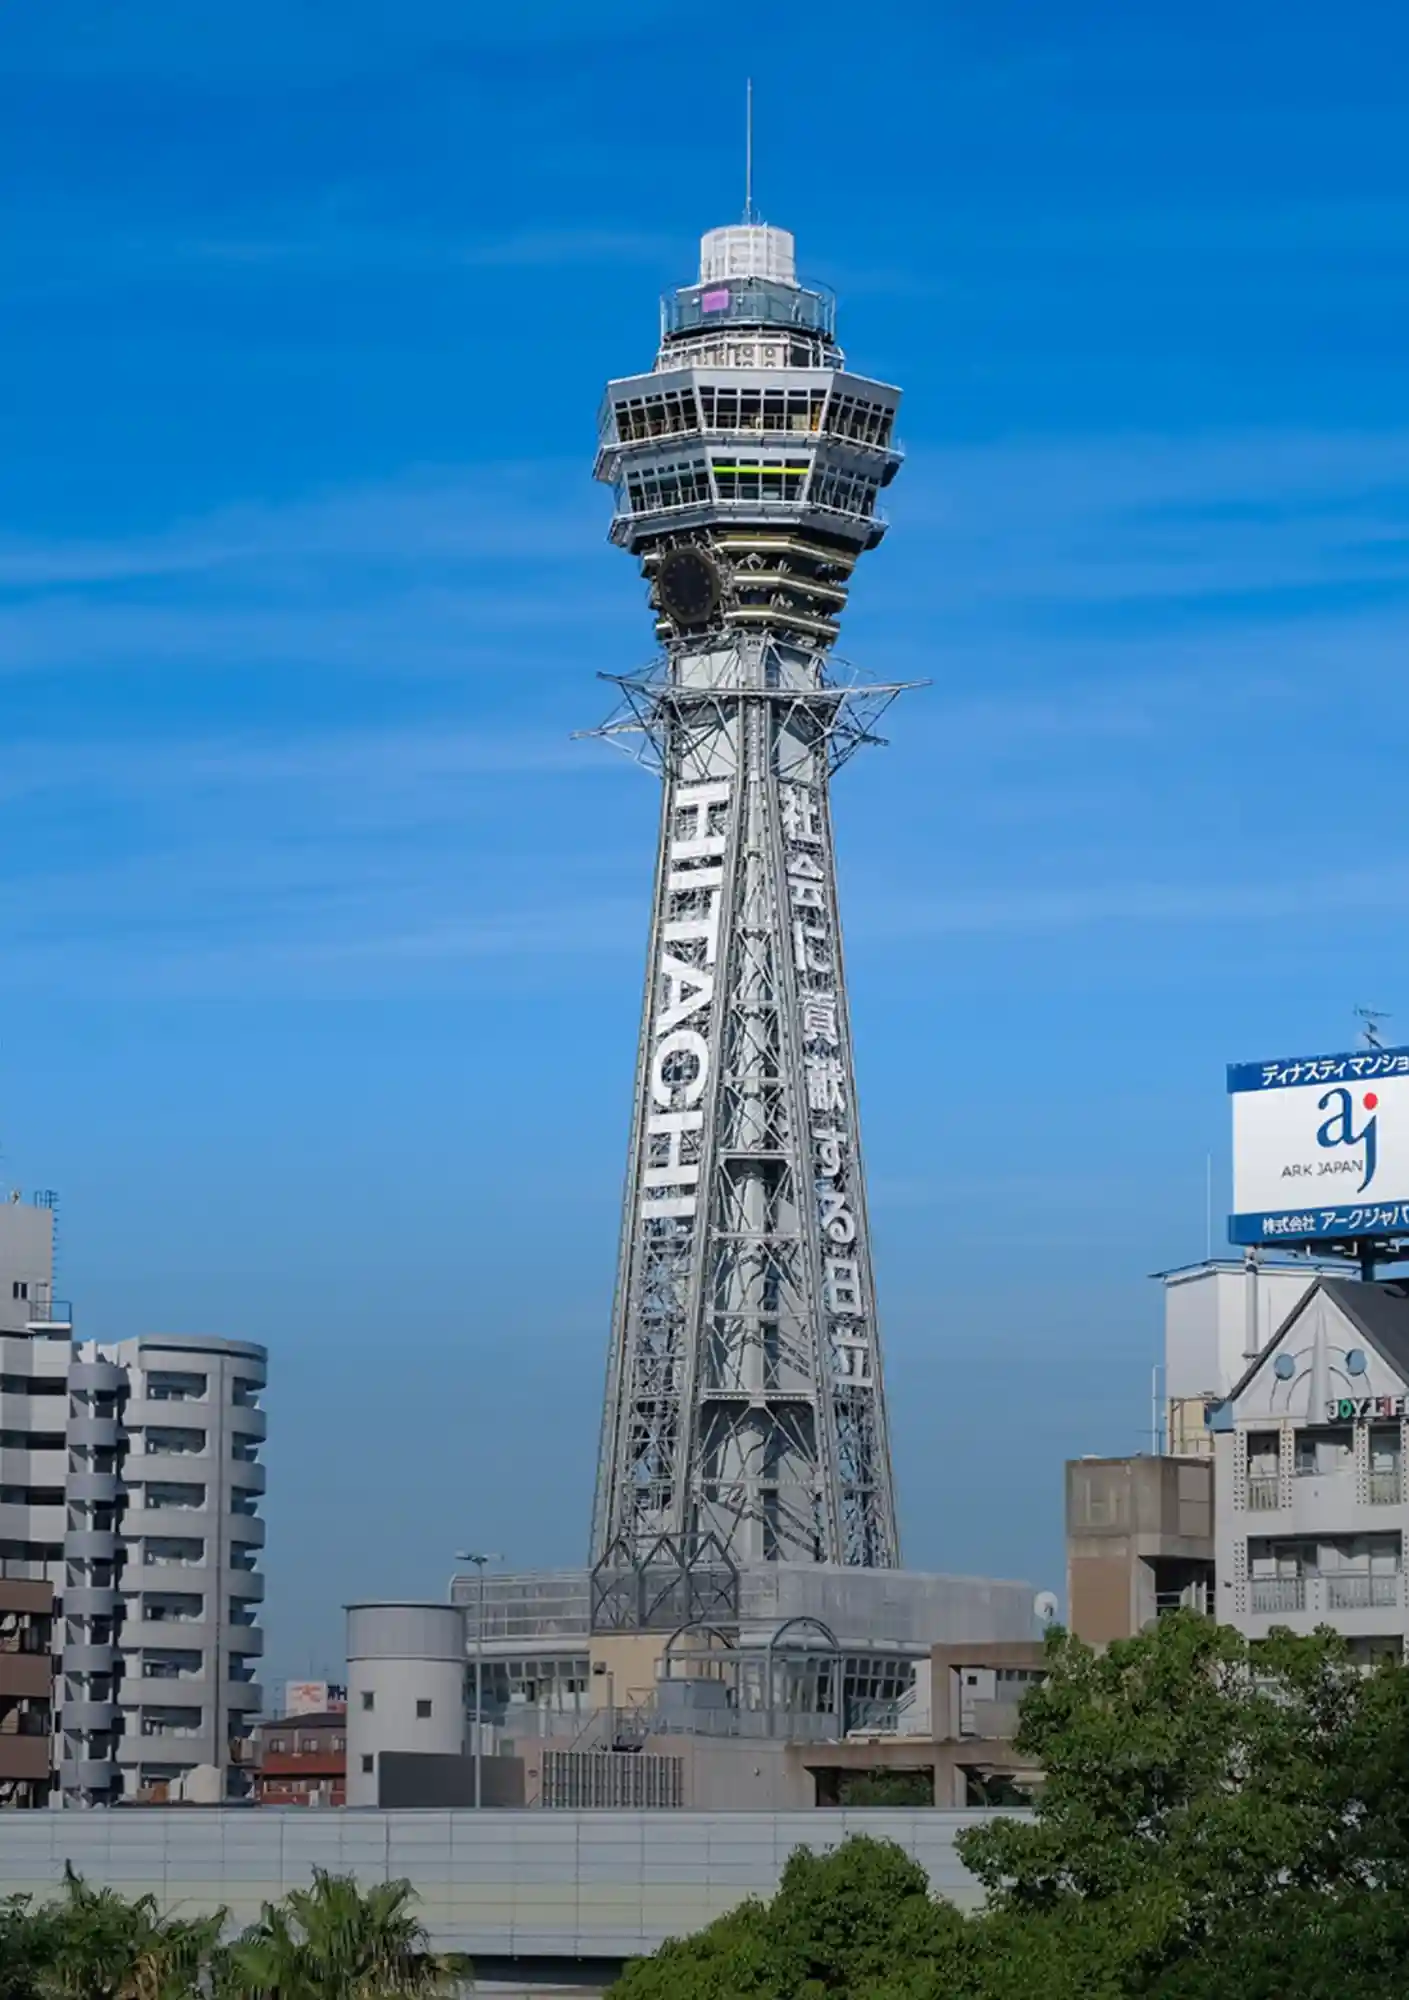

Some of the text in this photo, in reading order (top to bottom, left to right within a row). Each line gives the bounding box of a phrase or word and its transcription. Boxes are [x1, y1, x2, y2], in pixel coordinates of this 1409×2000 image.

[641, 783, 730, 1219] HITACHI
[1281, 1159, 1363, 1178] ARK JAPAN
